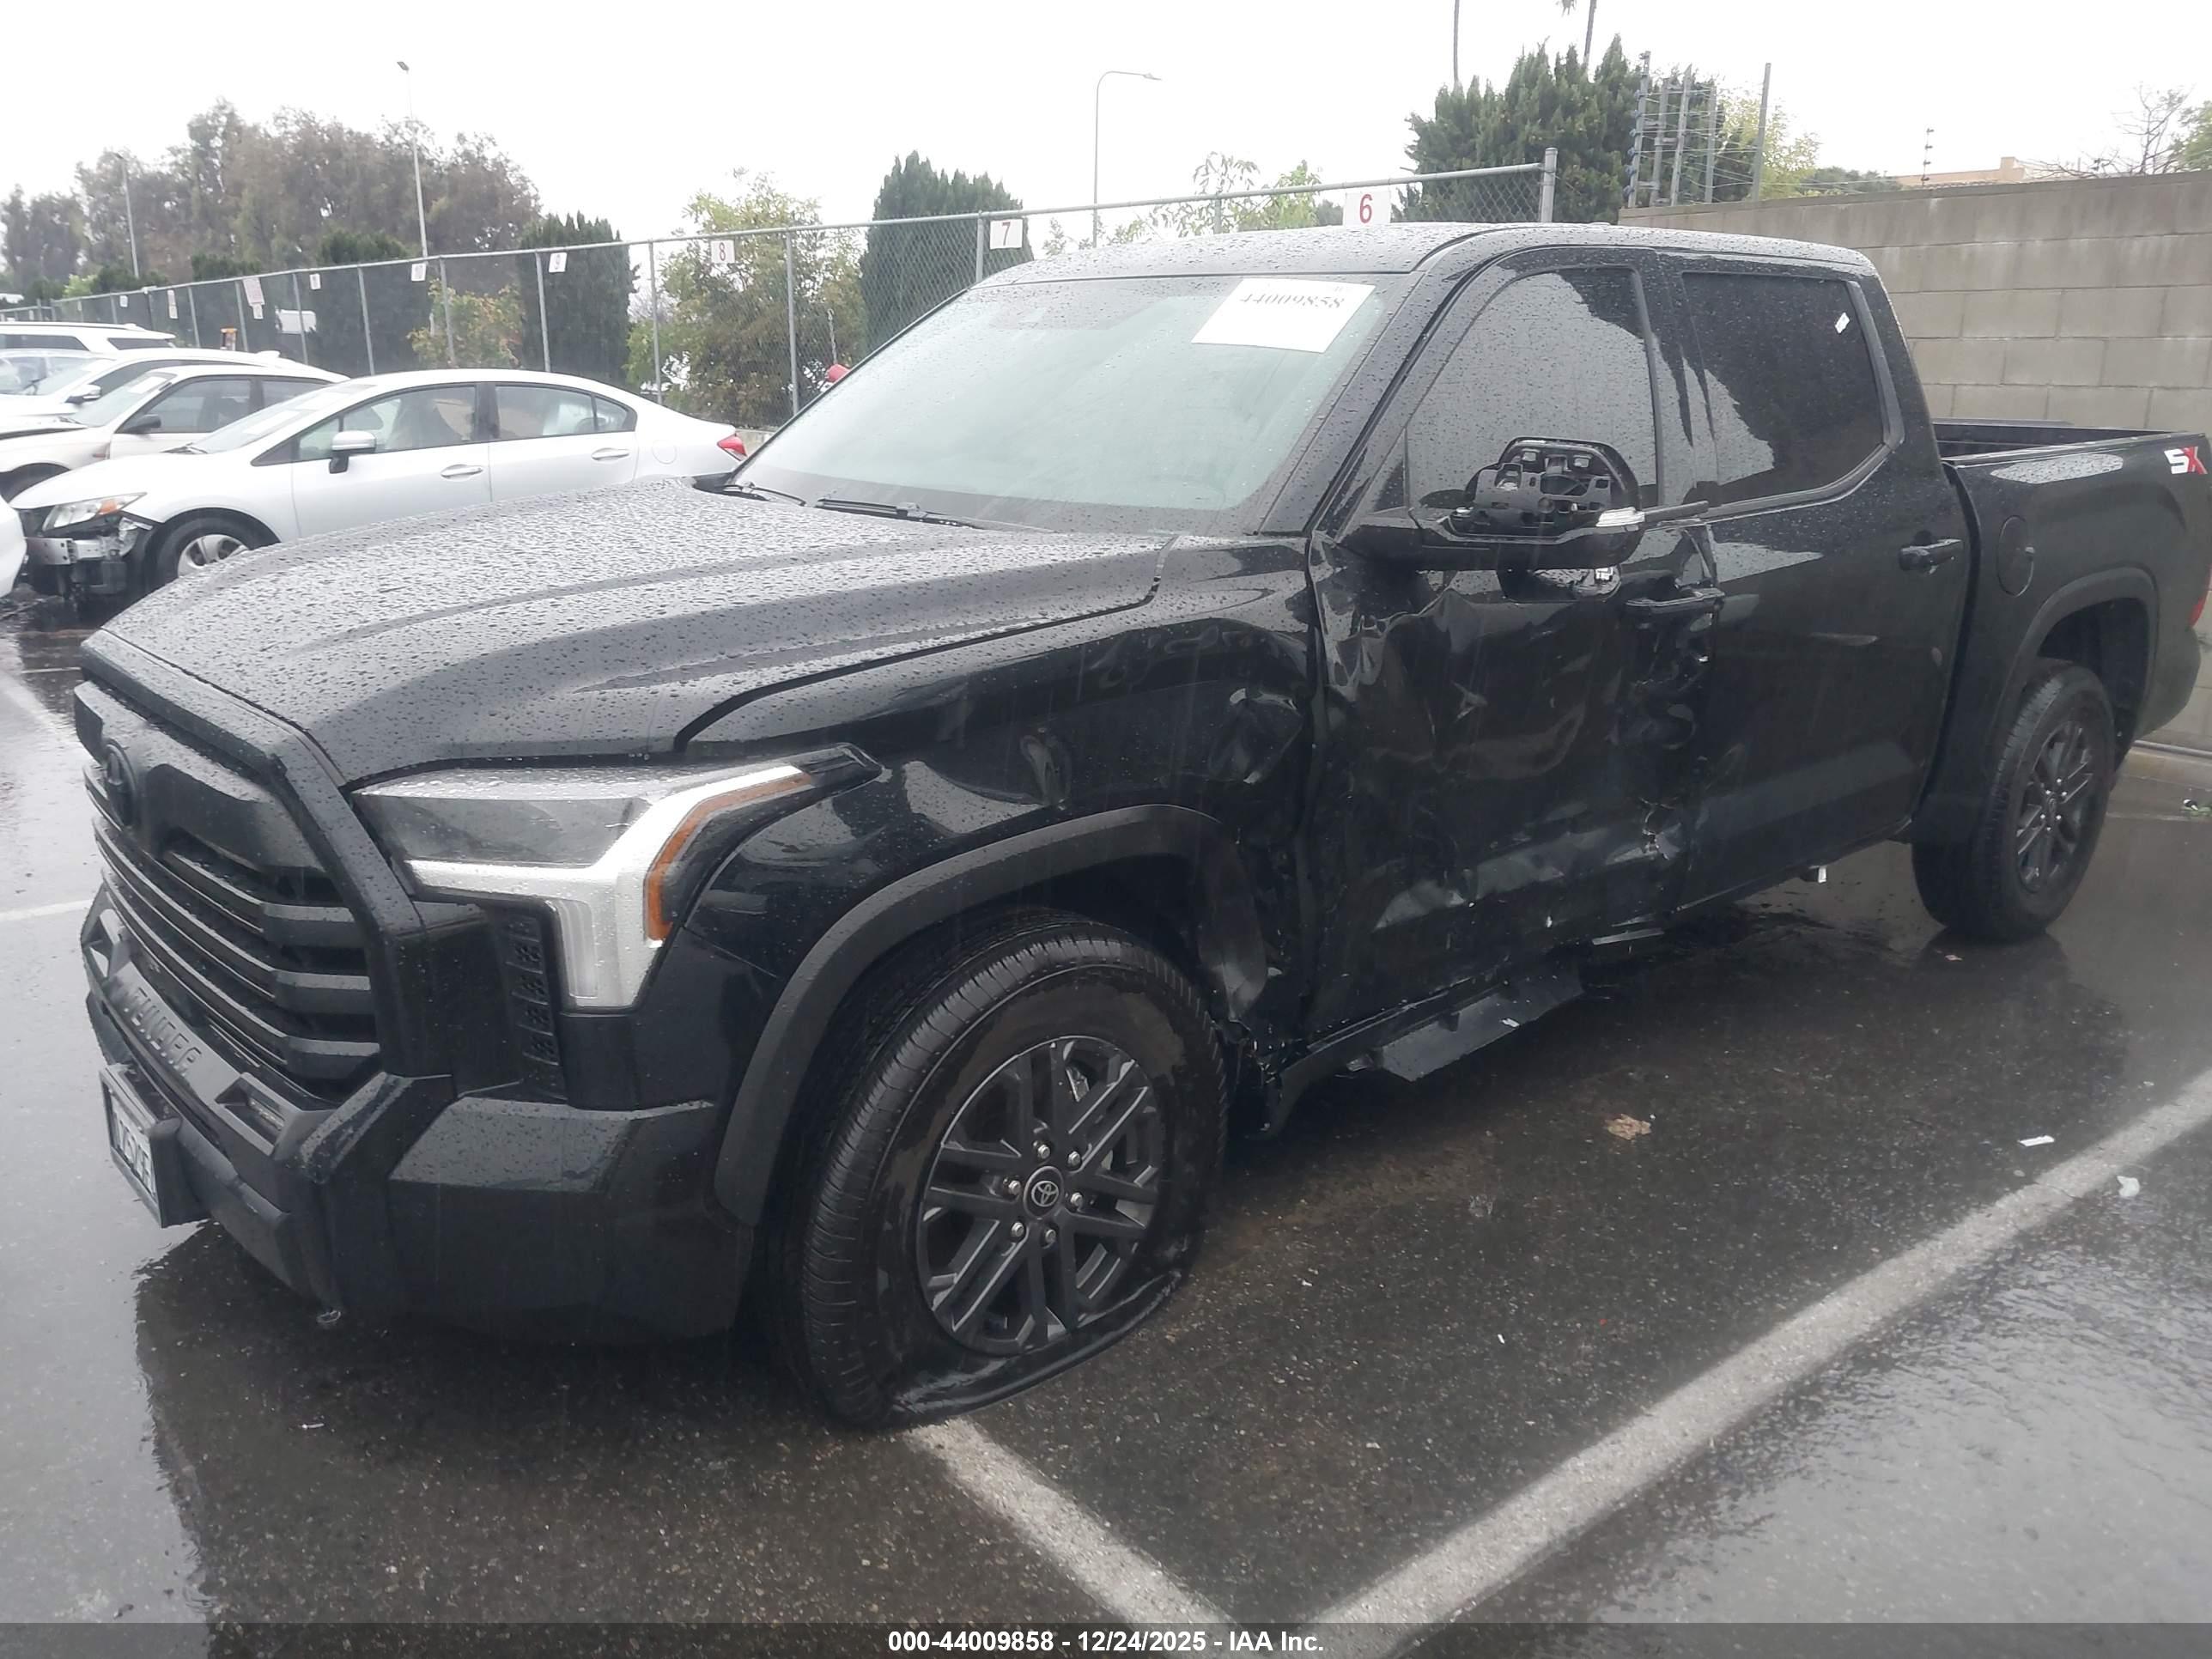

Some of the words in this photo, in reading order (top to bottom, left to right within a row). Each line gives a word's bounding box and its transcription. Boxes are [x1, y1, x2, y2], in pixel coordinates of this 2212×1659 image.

[1359, 193, 1372, 223] 6
[1002, 221, 1011, 246] 7
[719, 241, 726, 261] 8
